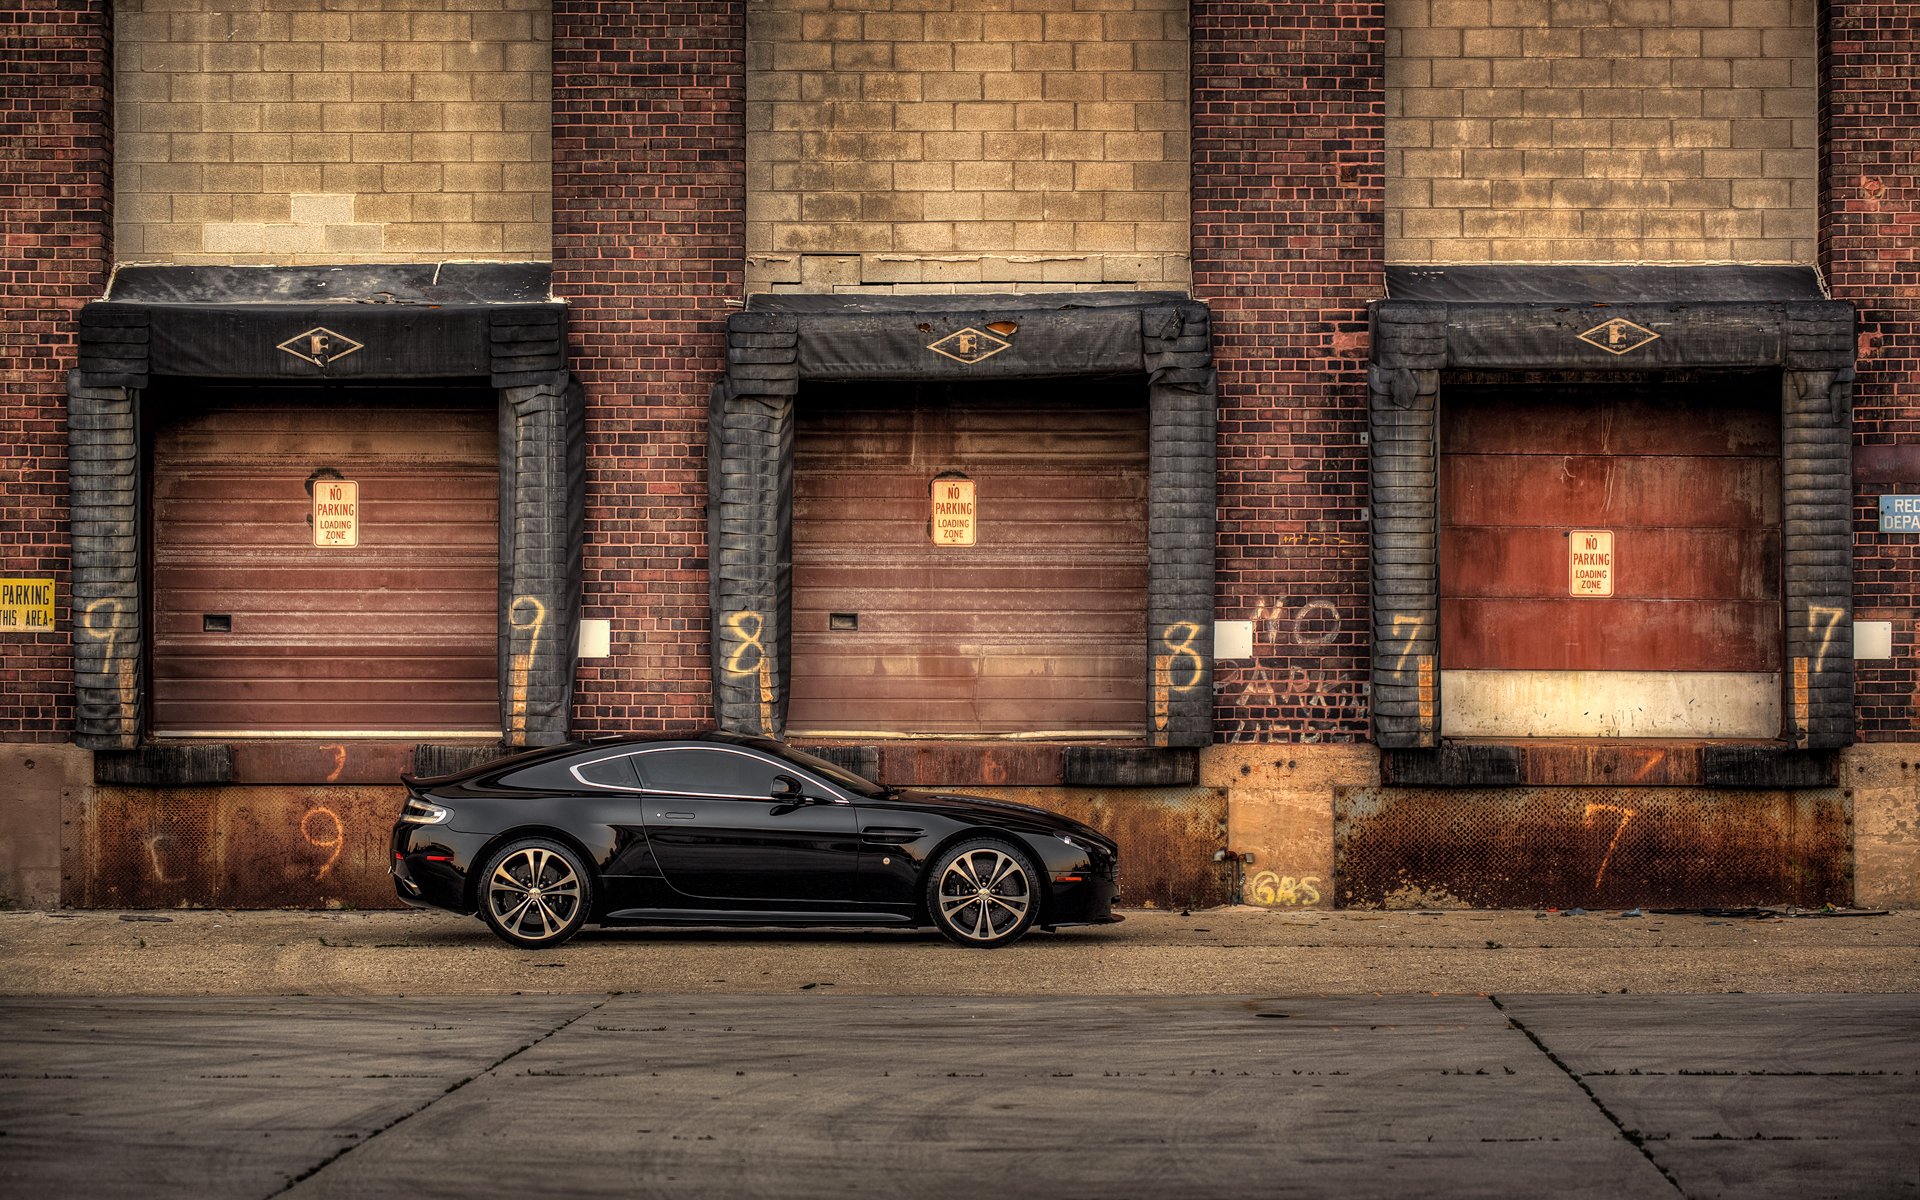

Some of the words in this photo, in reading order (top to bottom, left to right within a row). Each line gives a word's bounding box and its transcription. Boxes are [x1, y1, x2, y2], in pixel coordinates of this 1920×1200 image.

[329, 487, 342, 501] NO
[947, 486, 960, 500] NO
[317, 503, 355, 516] PARKING
[935, 502, 973, 515] PARKING
[1894, 498, 1920, 513] REC
[320, 520, 352, 530] LOADING
[937, 519, 970, 528] LOADING
[1884, 515, 1920, 530] DEPA
[325, 530, 346, 540] ZONE
[943, 529, 964, 539] ZONE
[1585, 537, 1598, 550] NO
[1573, 552, 1610, 566] PARKING
[1575, 569, 1607, 579] LOADING
[1581, 580, 1602, 589] ZONE
[2, 584, 50, 606] PARKING
[25, 610, 49, 627] AREA
[83, 597, 122, 674] 9
[508, 595, 545, 670] 9
[1807, 603, 1845, 673] 7
[726, 611, 766, 678] 8
[1392, 612, 1425, 679] 7
[1163, 620, 1203, 691] 8
[300, 805, 344, 882] 9
[1584, 802, 1636, 892] 7
